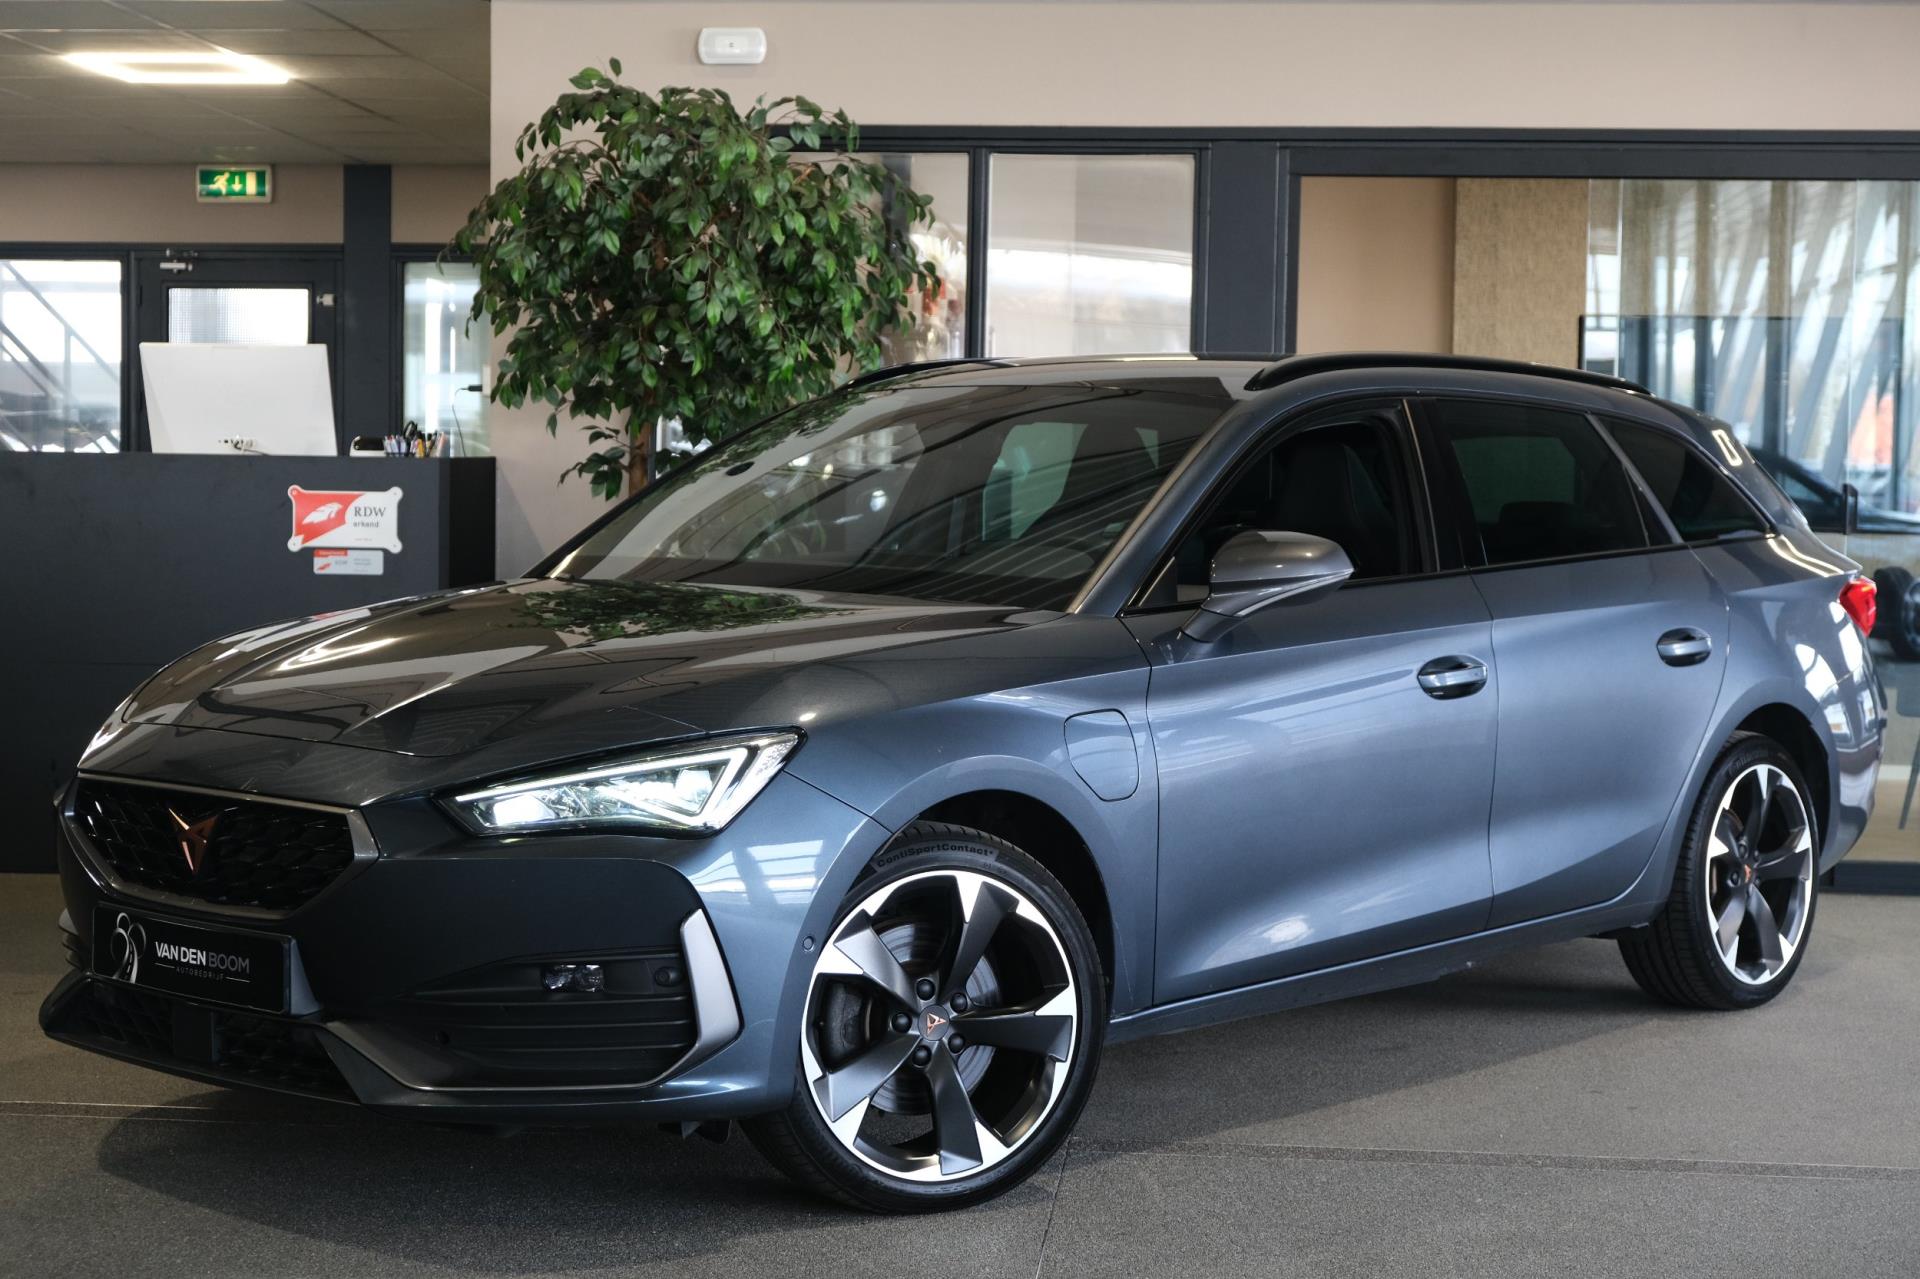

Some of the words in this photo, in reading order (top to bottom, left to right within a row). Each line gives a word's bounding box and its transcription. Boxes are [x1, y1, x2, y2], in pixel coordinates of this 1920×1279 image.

[354, 506, 386, 517] RDW
[155, 941, 179, 960] VAN
[180, 947, 206, 965] DEN
[208, 952, 250, 974] BOOM
